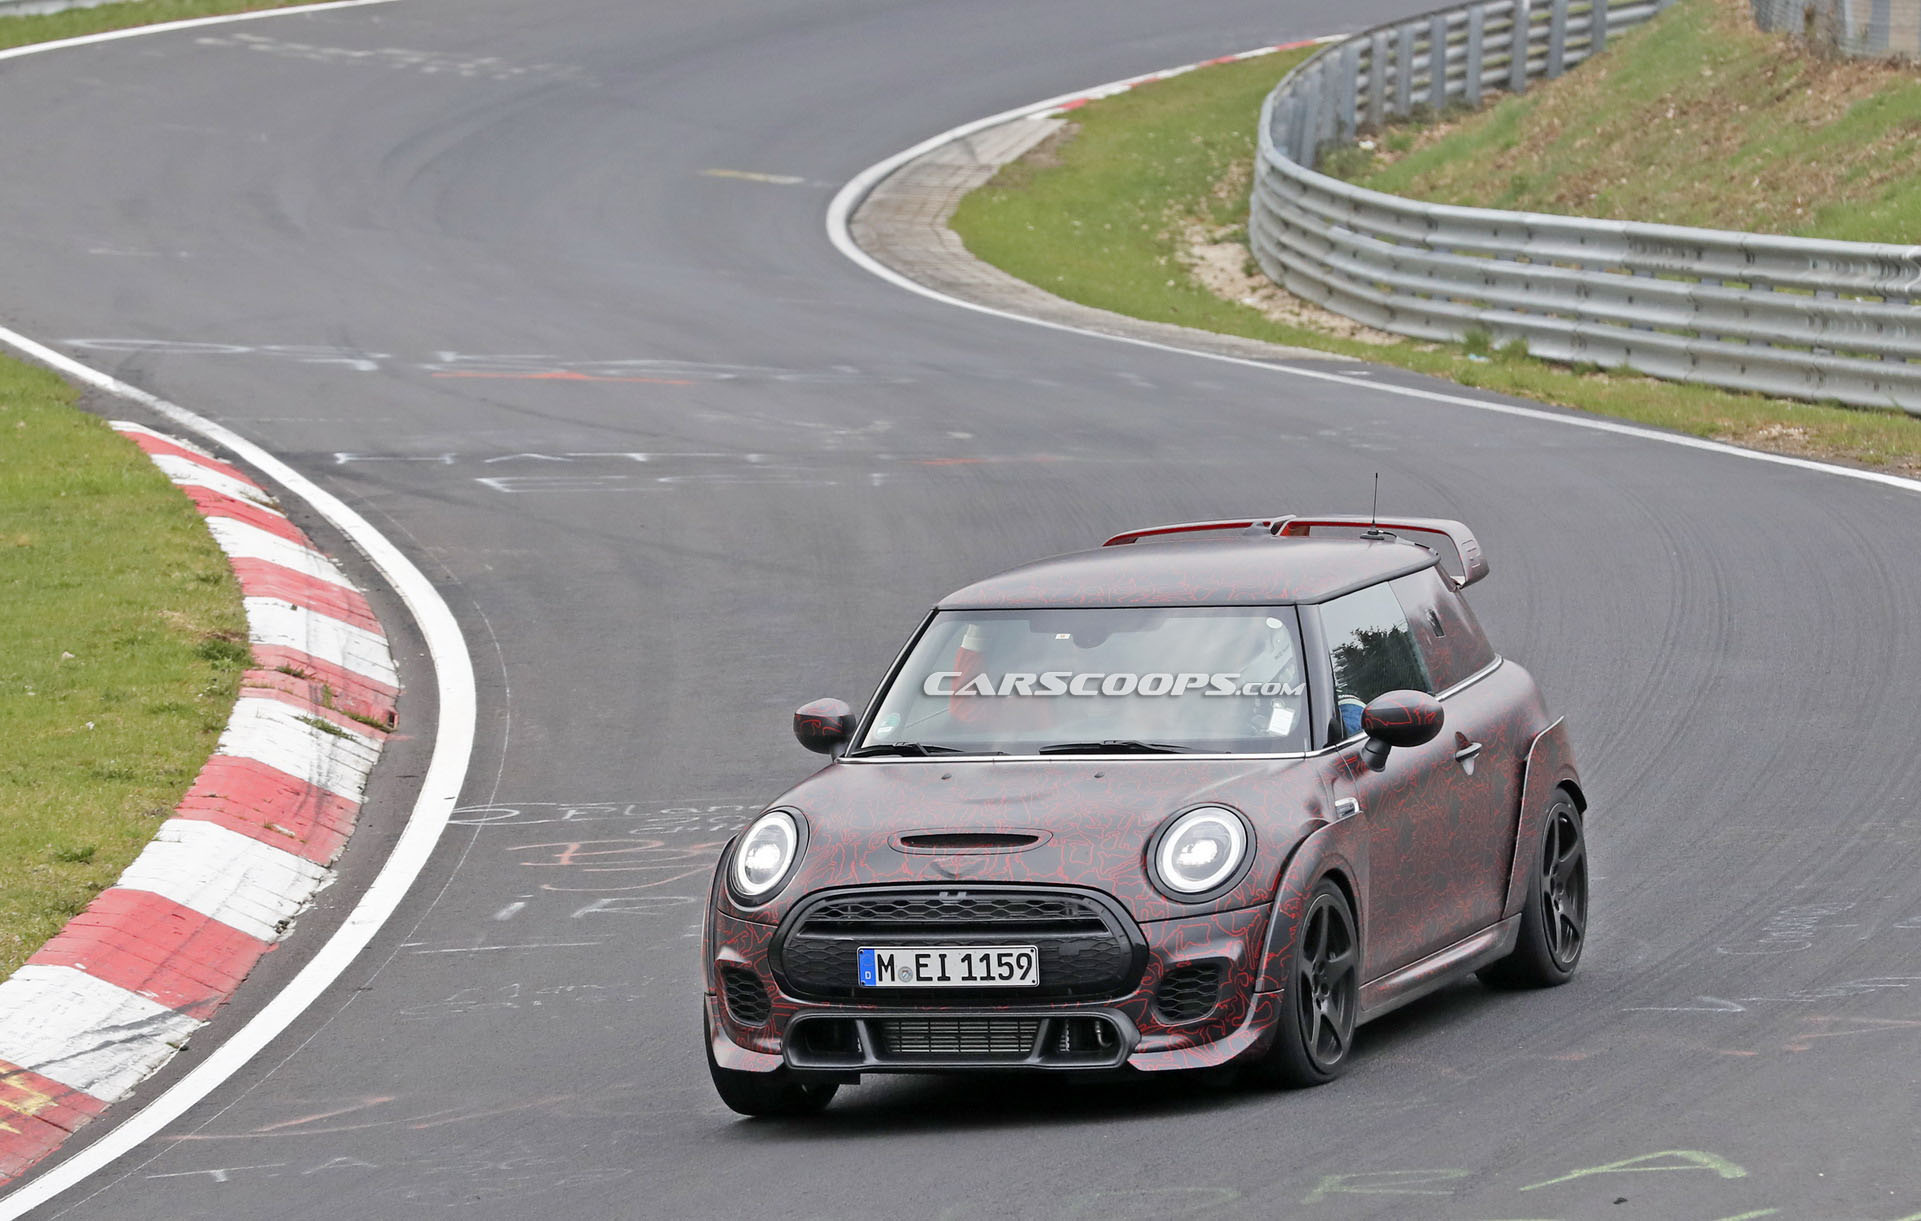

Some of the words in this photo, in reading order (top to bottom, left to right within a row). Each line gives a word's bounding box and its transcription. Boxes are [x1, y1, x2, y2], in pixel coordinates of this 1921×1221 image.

[865, 971, 872, 980] D
[877, 953, 895, 982] M
[915, 953, 951, 982] EI
[961, 952, 1033, 982] 1159
